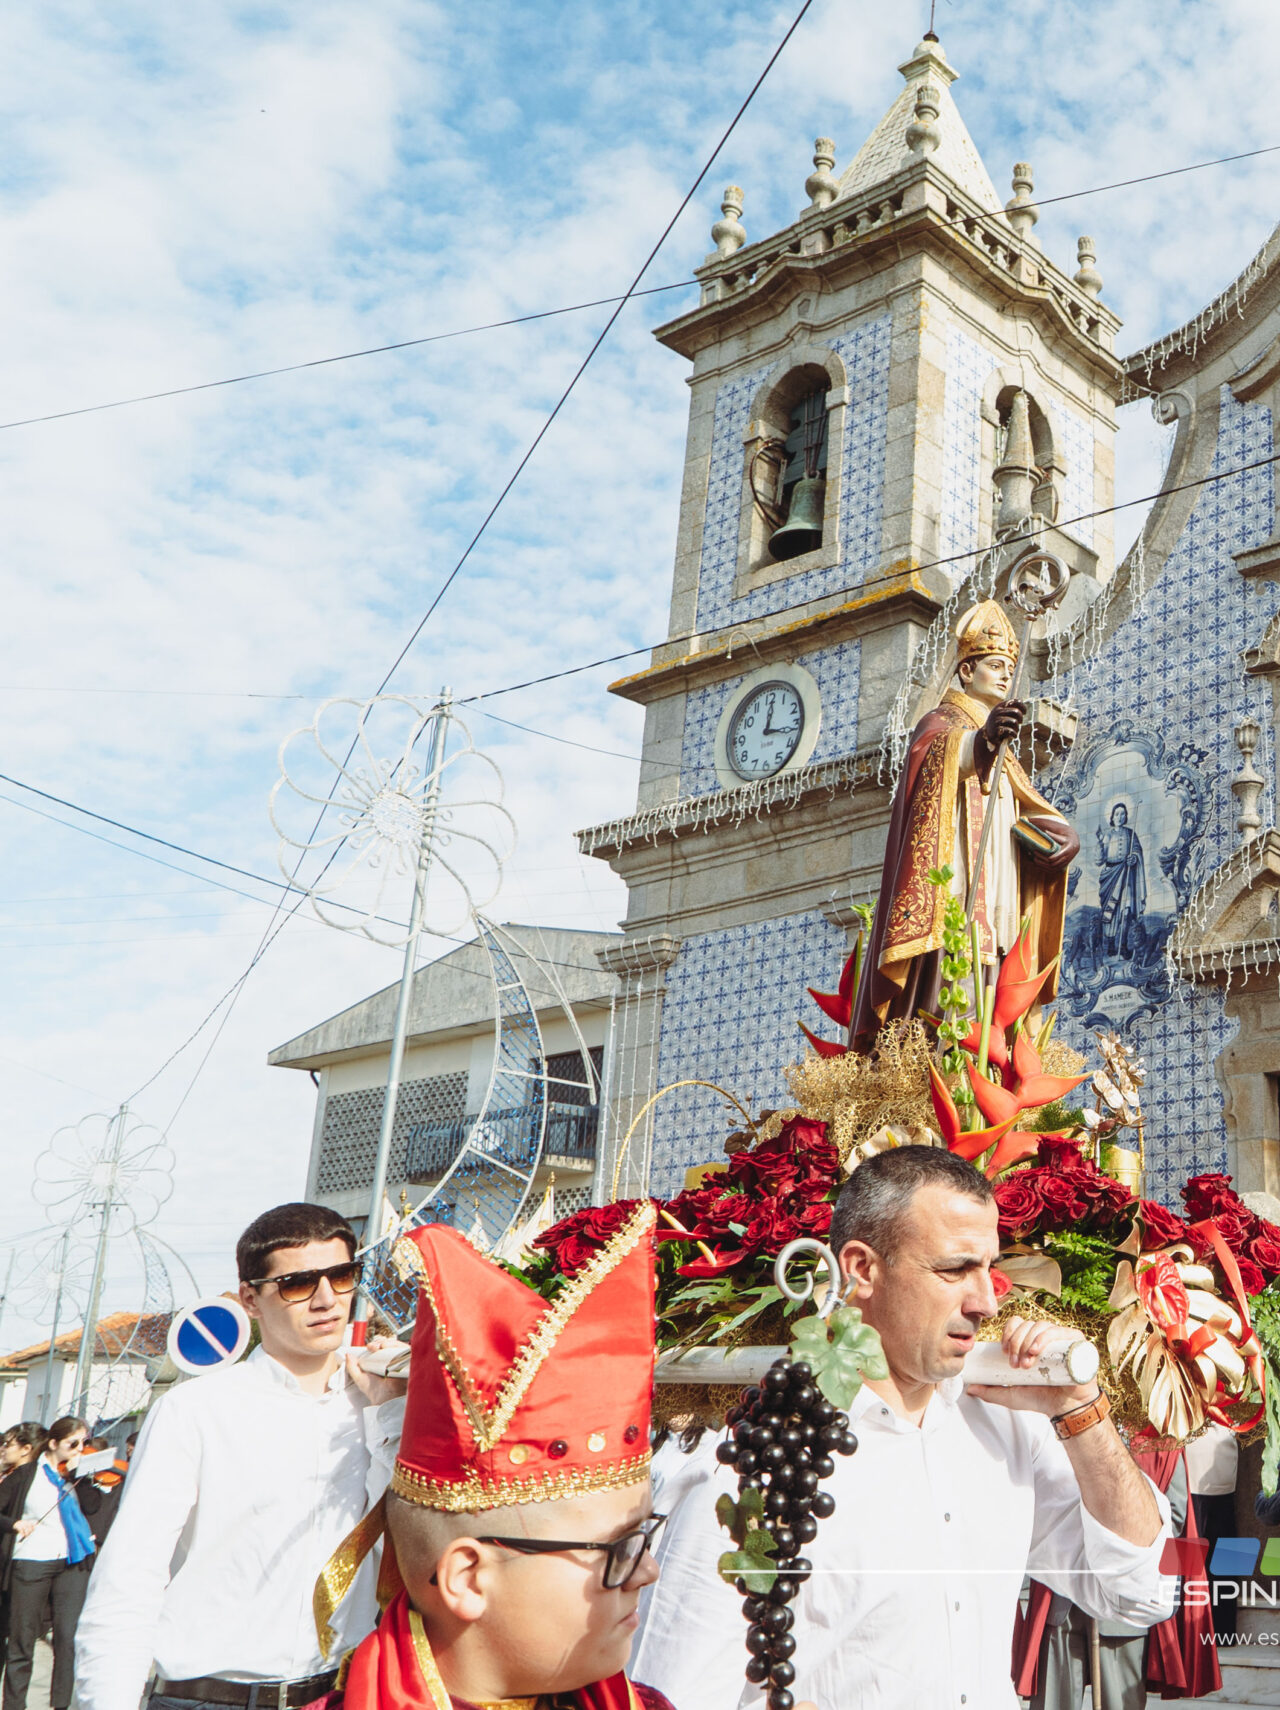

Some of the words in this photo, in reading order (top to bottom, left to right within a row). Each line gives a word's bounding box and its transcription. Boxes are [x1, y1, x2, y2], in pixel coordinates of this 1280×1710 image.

[765, 692, 775, 706] 12
[754, 701, 759, 714] 11
[790, 702, 798, 715] 2
[744, 716, 754, 729] 10
[738, 735, 745, 747] 9
[786, 737, 794, 748] 4
[741, 750, 748, 762] 8
[775, 751, 783, 764] 5
[751, 758, 759, 771] 7
[763, 760, 770, 771] 6
